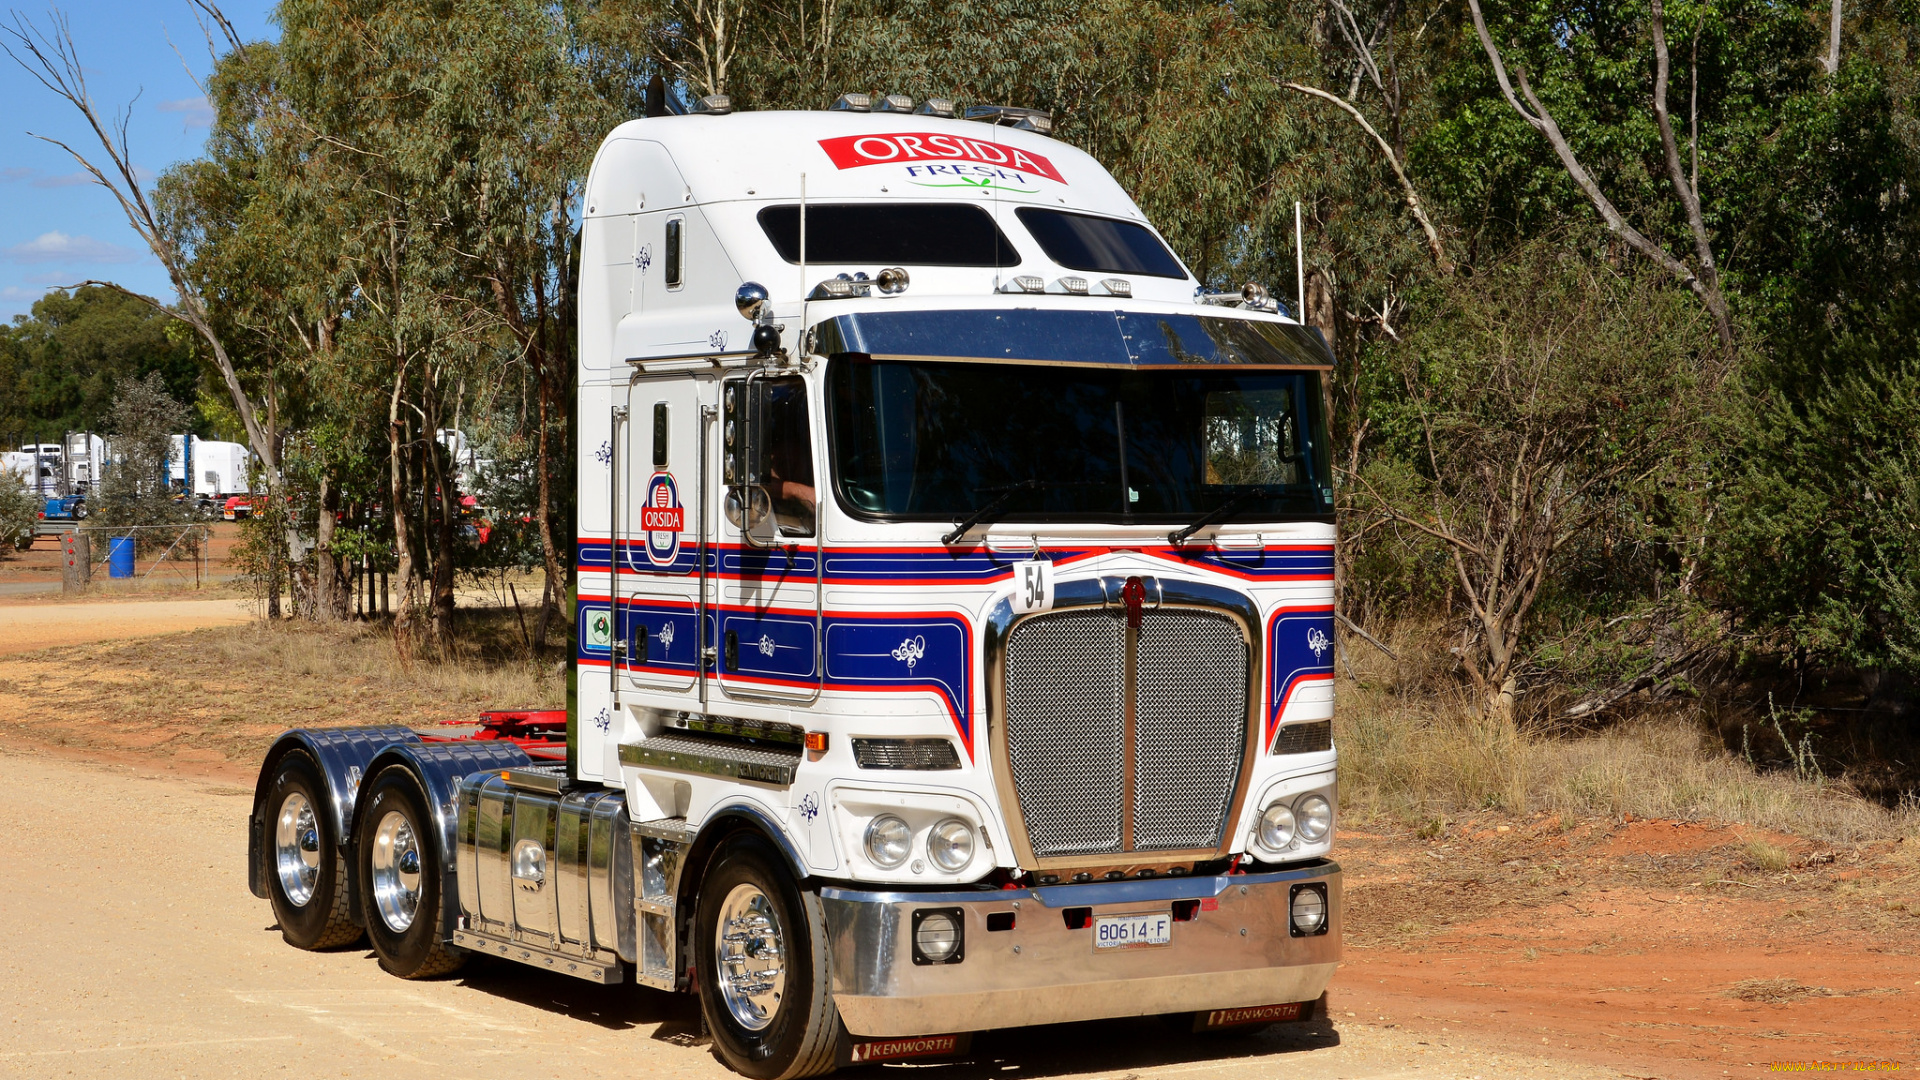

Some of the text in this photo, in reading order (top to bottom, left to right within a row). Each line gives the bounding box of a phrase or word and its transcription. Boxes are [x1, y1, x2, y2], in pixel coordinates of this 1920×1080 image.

[853, 135, 1050, 177] ORSIDA
[905, 163, 1027, 185] FRESH
[645, 511, 681, 528] ORSIDA
[1024, 565, 1045, 609] 54
[1226, 1005, 1299, 1022] KENWORTH
[872, 1038, 954, 1057] KENWORTH
